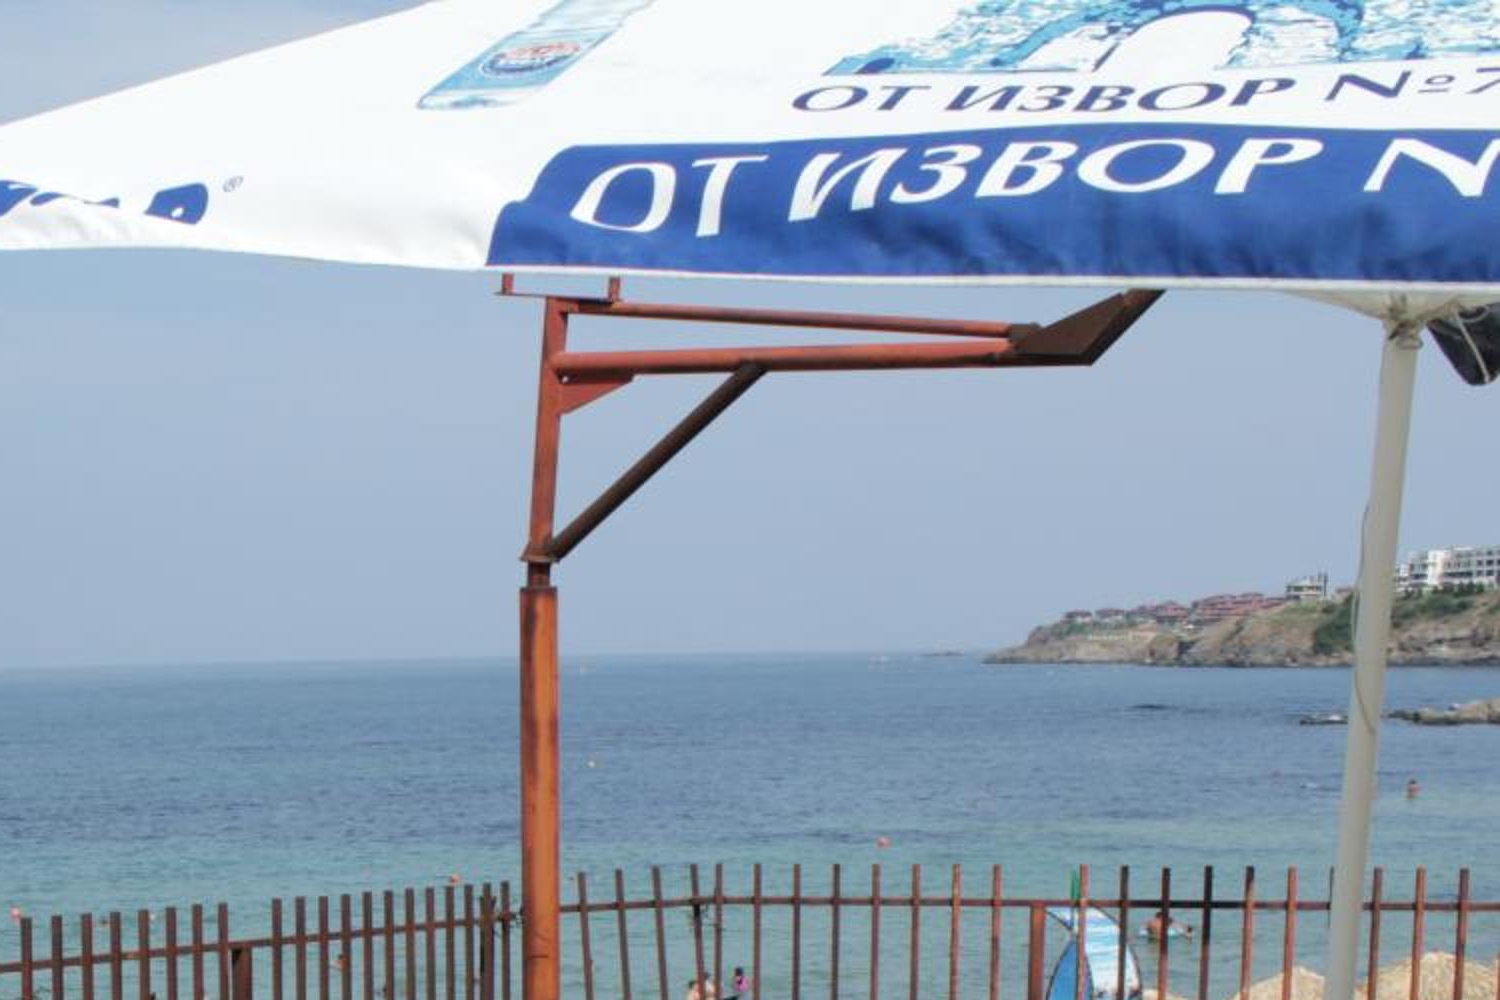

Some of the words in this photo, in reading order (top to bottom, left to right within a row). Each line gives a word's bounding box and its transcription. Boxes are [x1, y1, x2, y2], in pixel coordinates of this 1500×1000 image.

[791, 85, 932, 112] ОТ
[944, 77, 1296, 113] ИЗВОР
[569, 154, 768, 237] ОТ
[788, 138, 1323, 222] ИЗВОР
